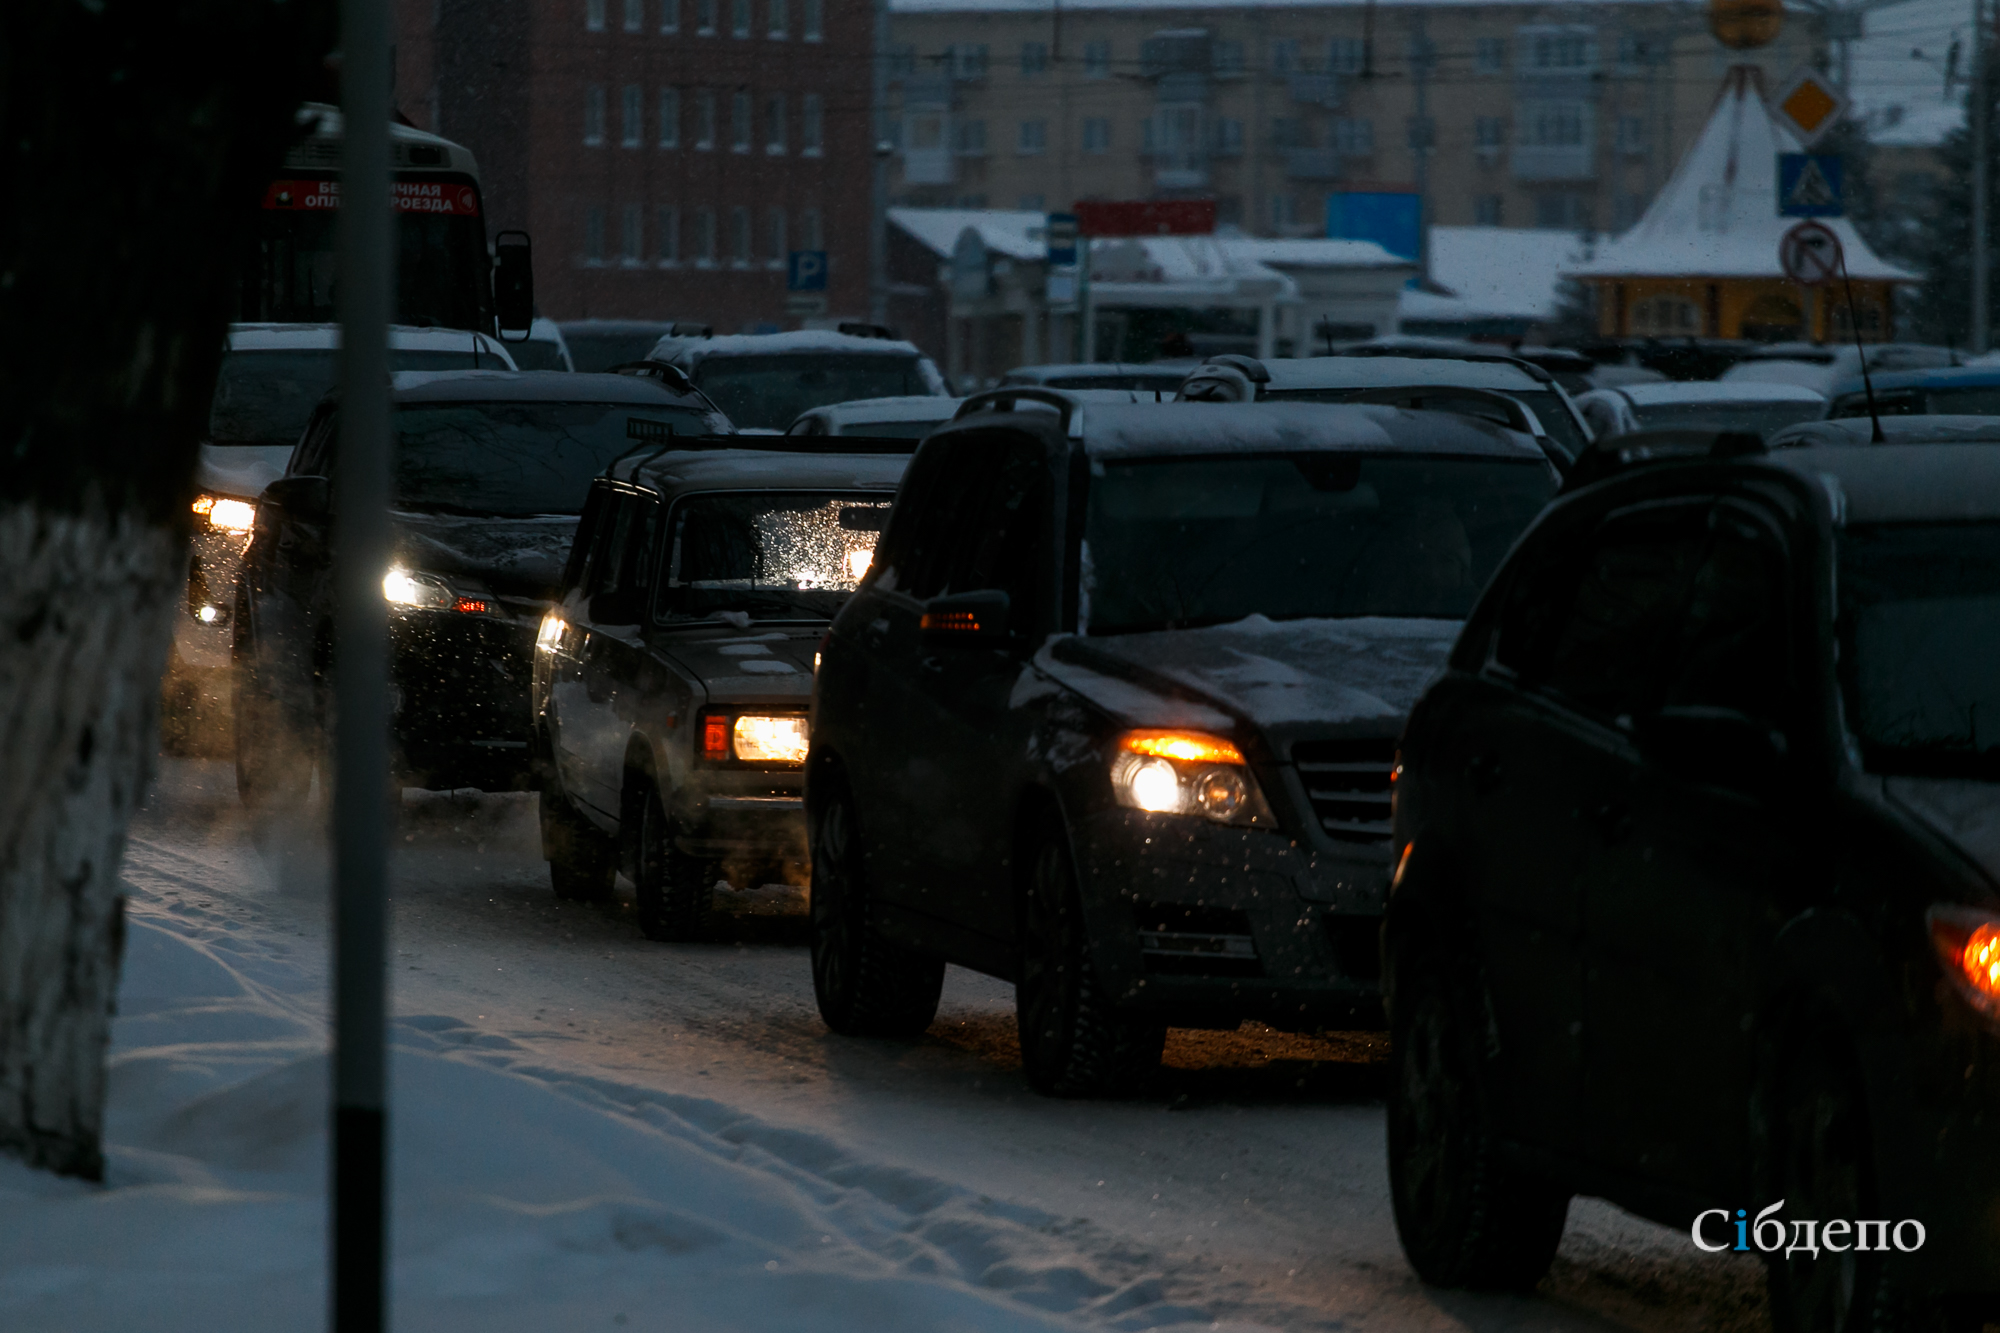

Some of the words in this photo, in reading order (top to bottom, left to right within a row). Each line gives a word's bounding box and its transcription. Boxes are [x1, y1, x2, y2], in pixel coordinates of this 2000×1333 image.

[318, 181, 442, 197] БЕИЧНАЯ
[389, 196, 454, 212] РОЕЗДА
[797, 255, 821, 288] P
